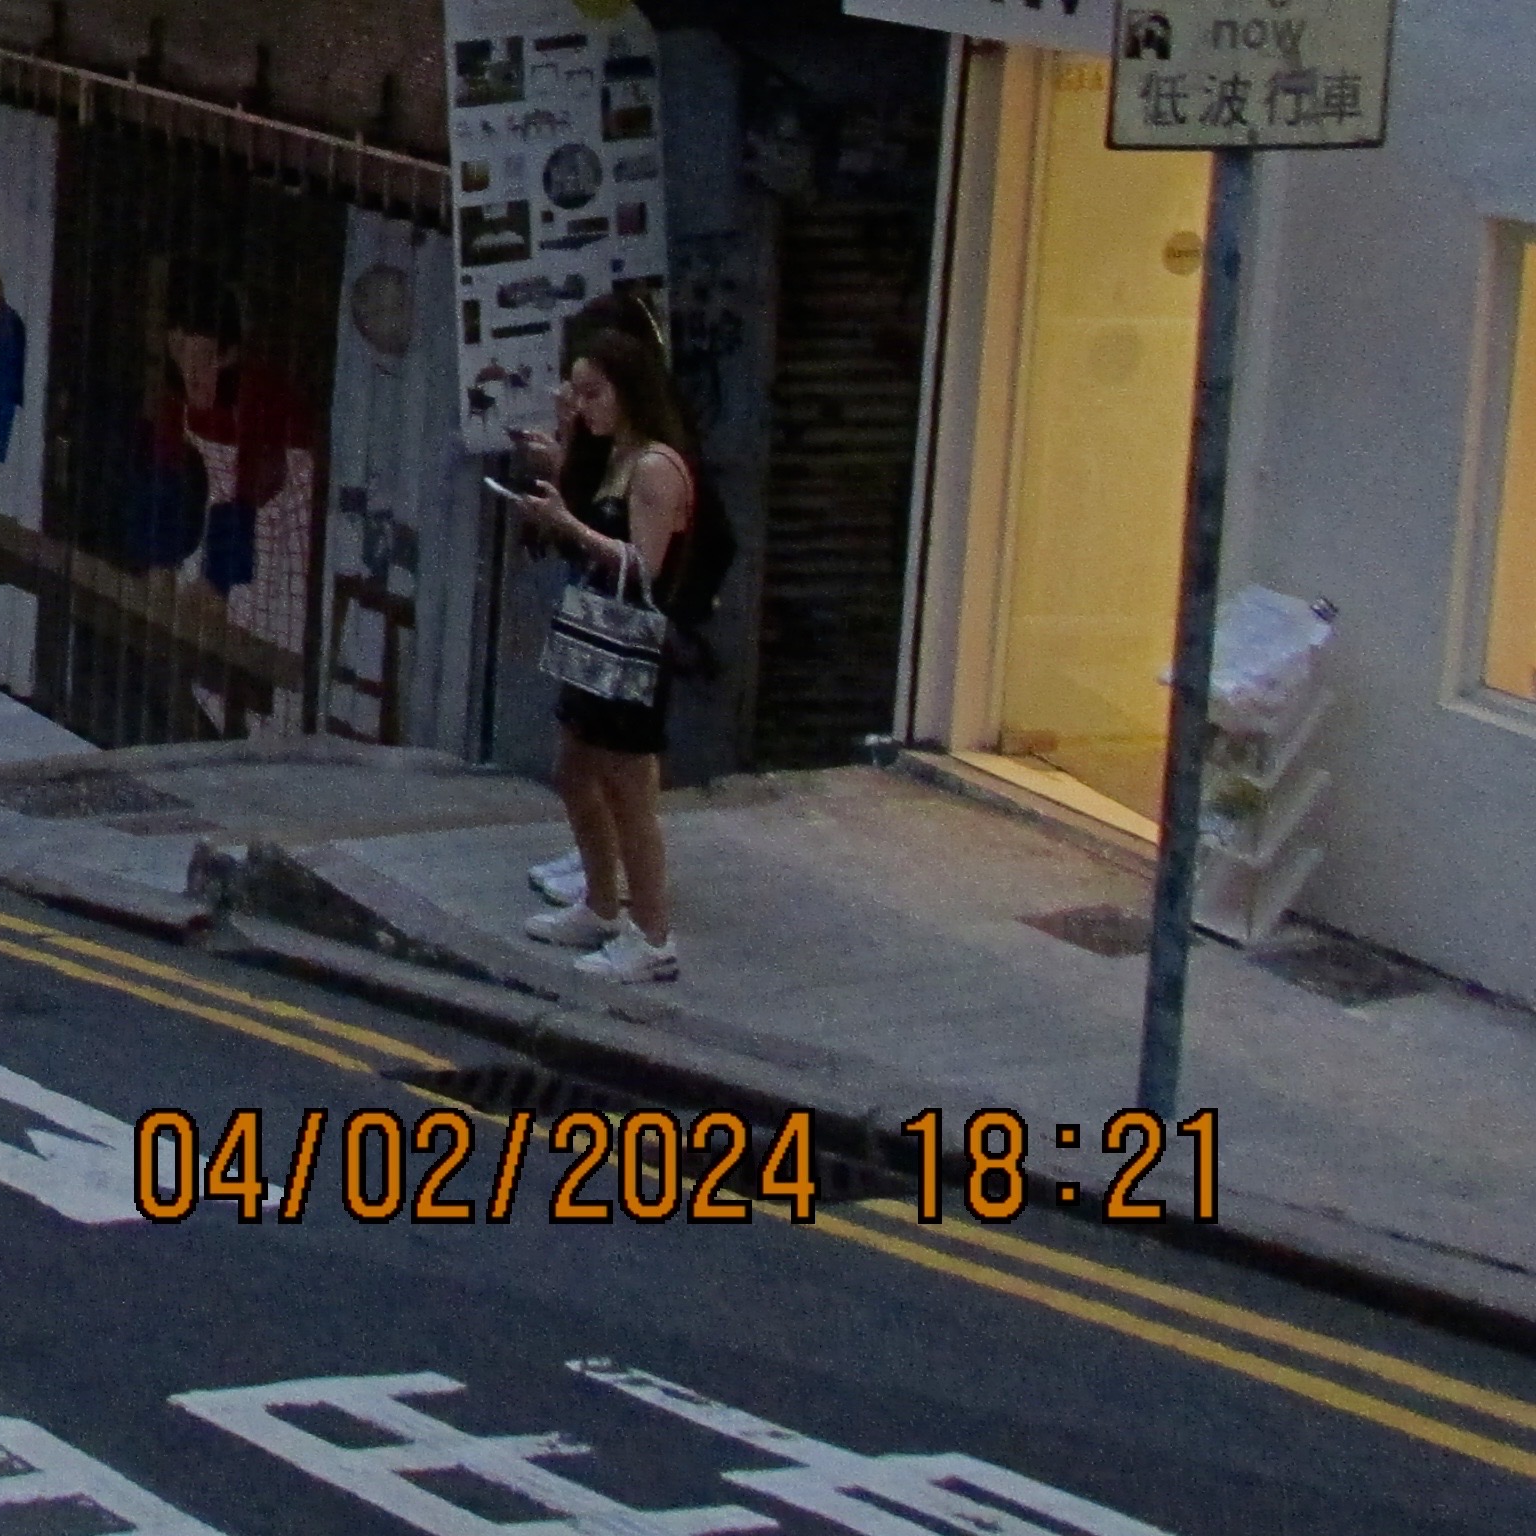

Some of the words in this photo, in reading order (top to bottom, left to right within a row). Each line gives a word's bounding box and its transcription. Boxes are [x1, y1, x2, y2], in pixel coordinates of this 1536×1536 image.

[1212, 19, 1305, 54] now
[1140, 69, 1362, 127] 低波行車
